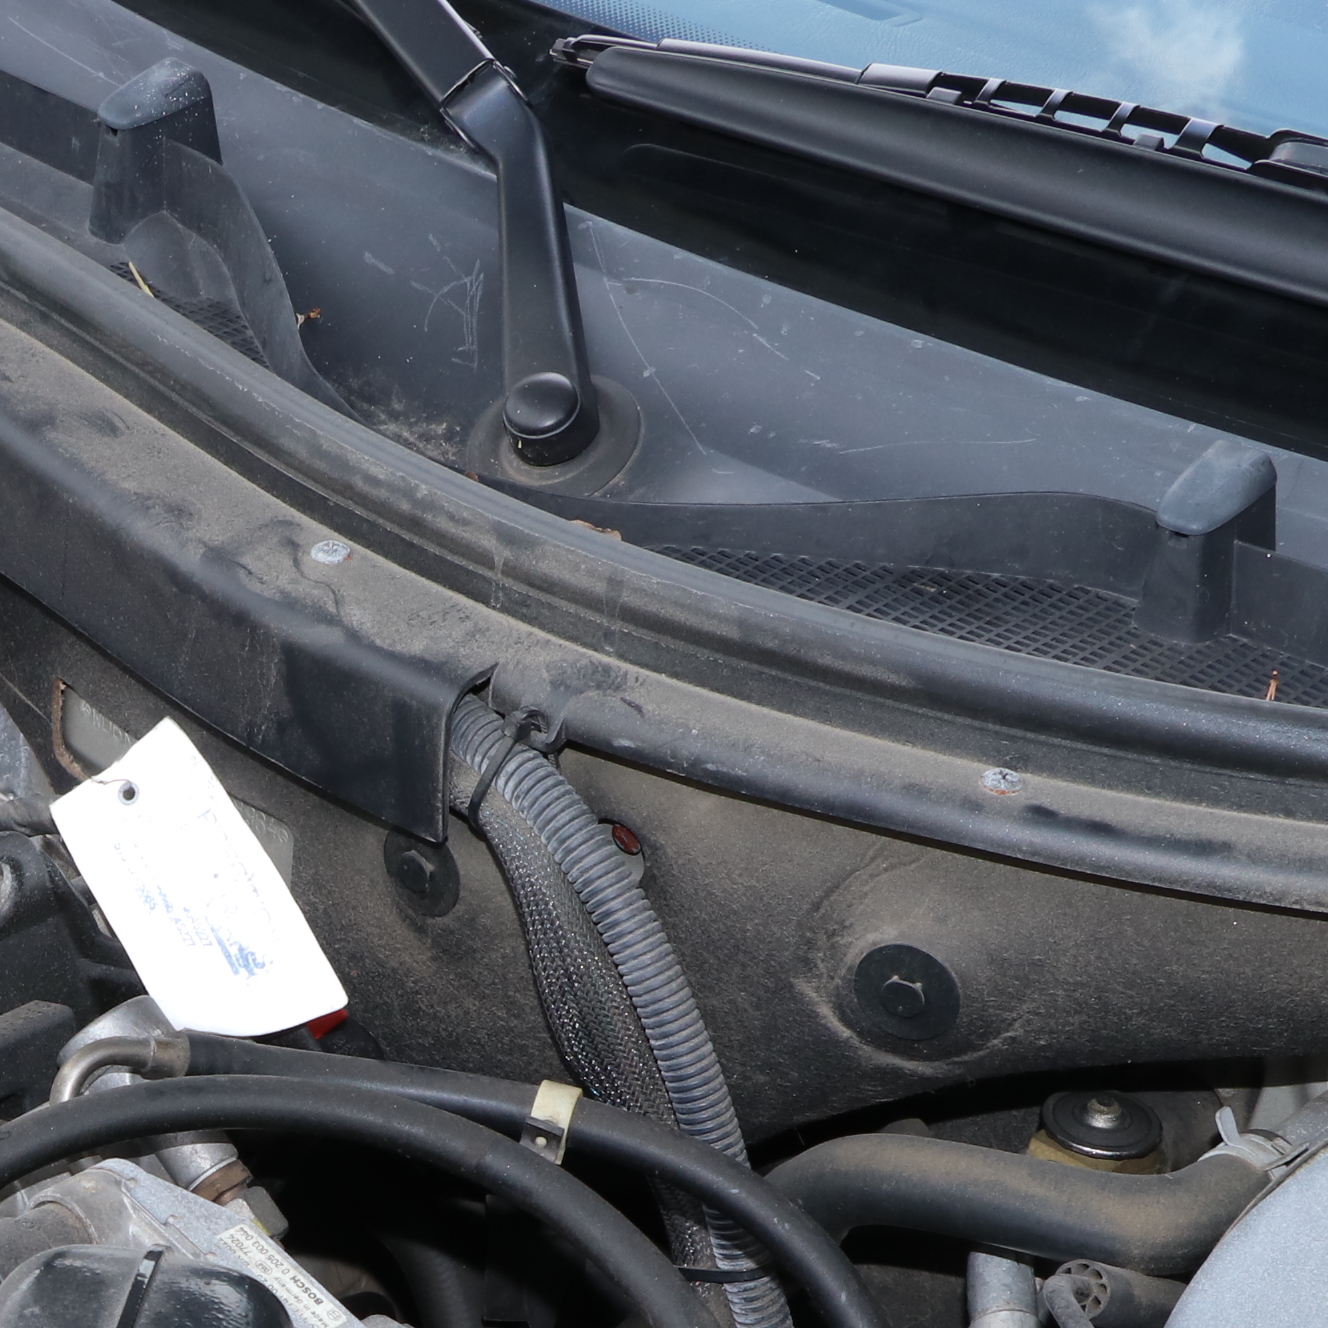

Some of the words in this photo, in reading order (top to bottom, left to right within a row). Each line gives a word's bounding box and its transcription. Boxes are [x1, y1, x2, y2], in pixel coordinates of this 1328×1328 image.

[238, 1226, 254, 1242] 044
[229, 1233, 251, 1256] 77024
[251, 1240, 269, 1256] 003
[267, 1254, 285, 1270] 205
[281, 1267, 291, 1275] 0
[273, 1276, 304, 1305] Germany
[289, 1275, 325, 1306] BOSCH
[303, 1303, 312, 1313] in
[310, 1307, 330, 1328] Made
